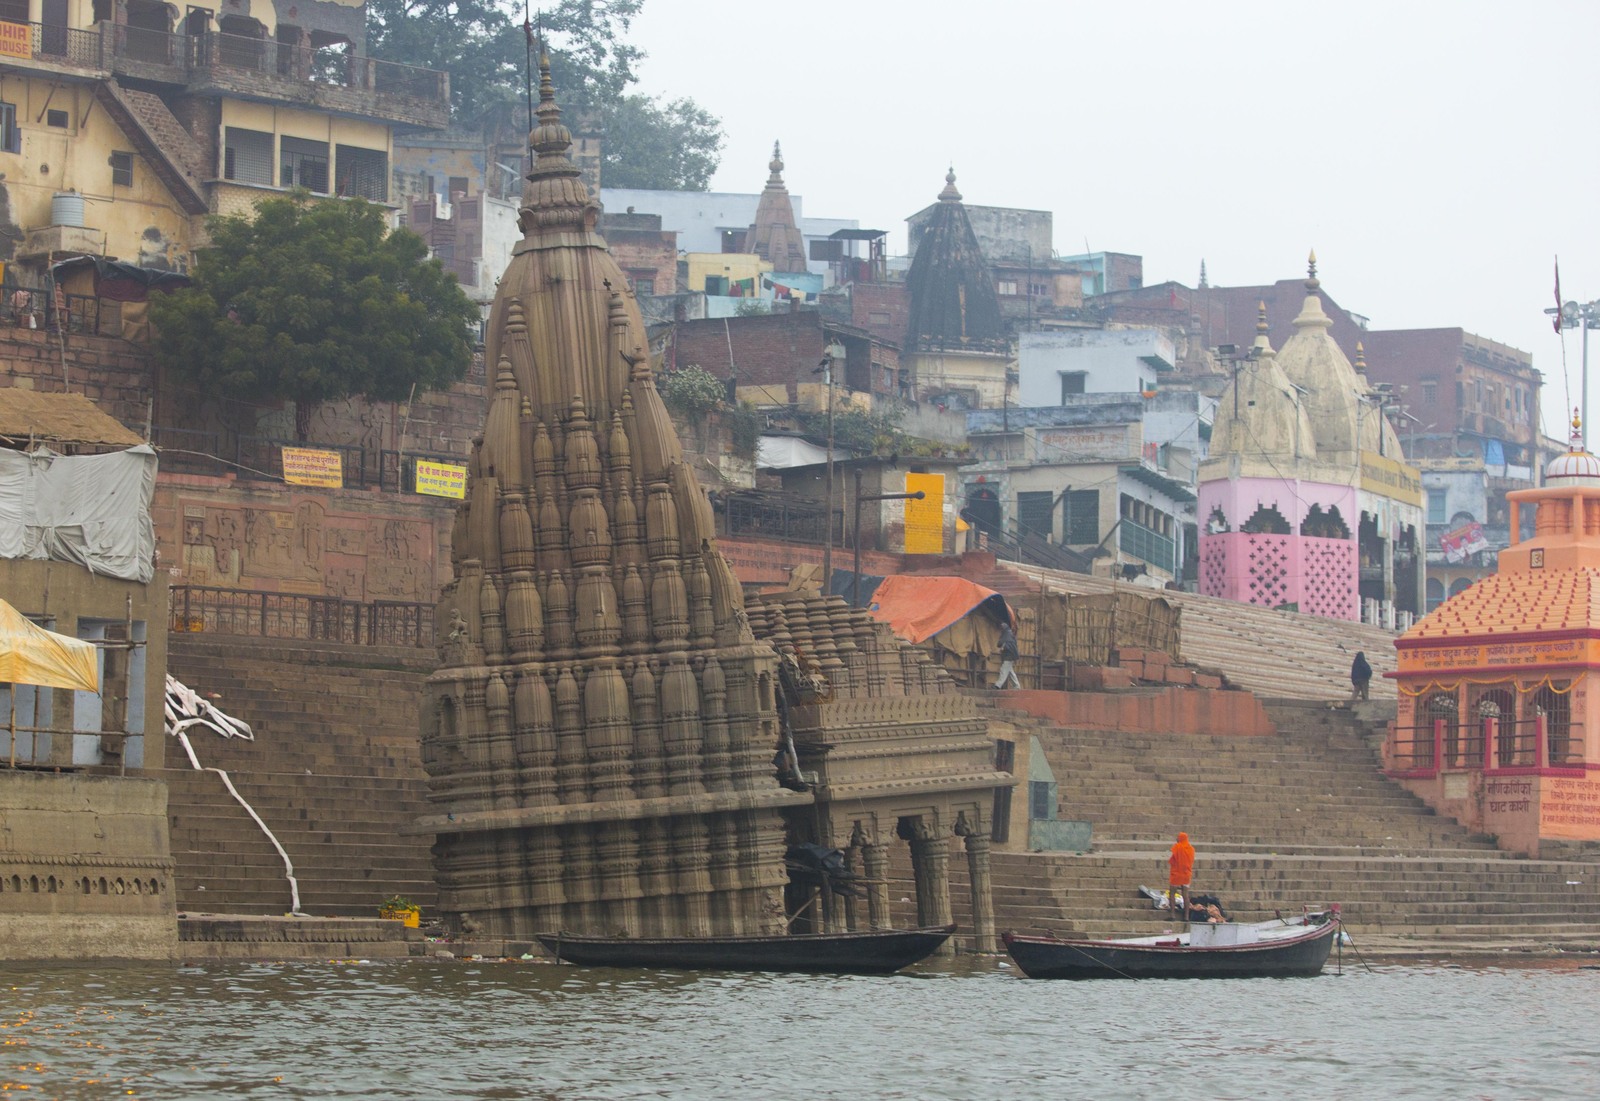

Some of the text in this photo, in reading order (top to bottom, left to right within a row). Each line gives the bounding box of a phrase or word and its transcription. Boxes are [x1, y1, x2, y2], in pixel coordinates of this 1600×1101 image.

[0, 24, 26, 40] HIA
[1489, 800, 1507, 813] घाट
[1508, 797, 1531, 812] काशी
